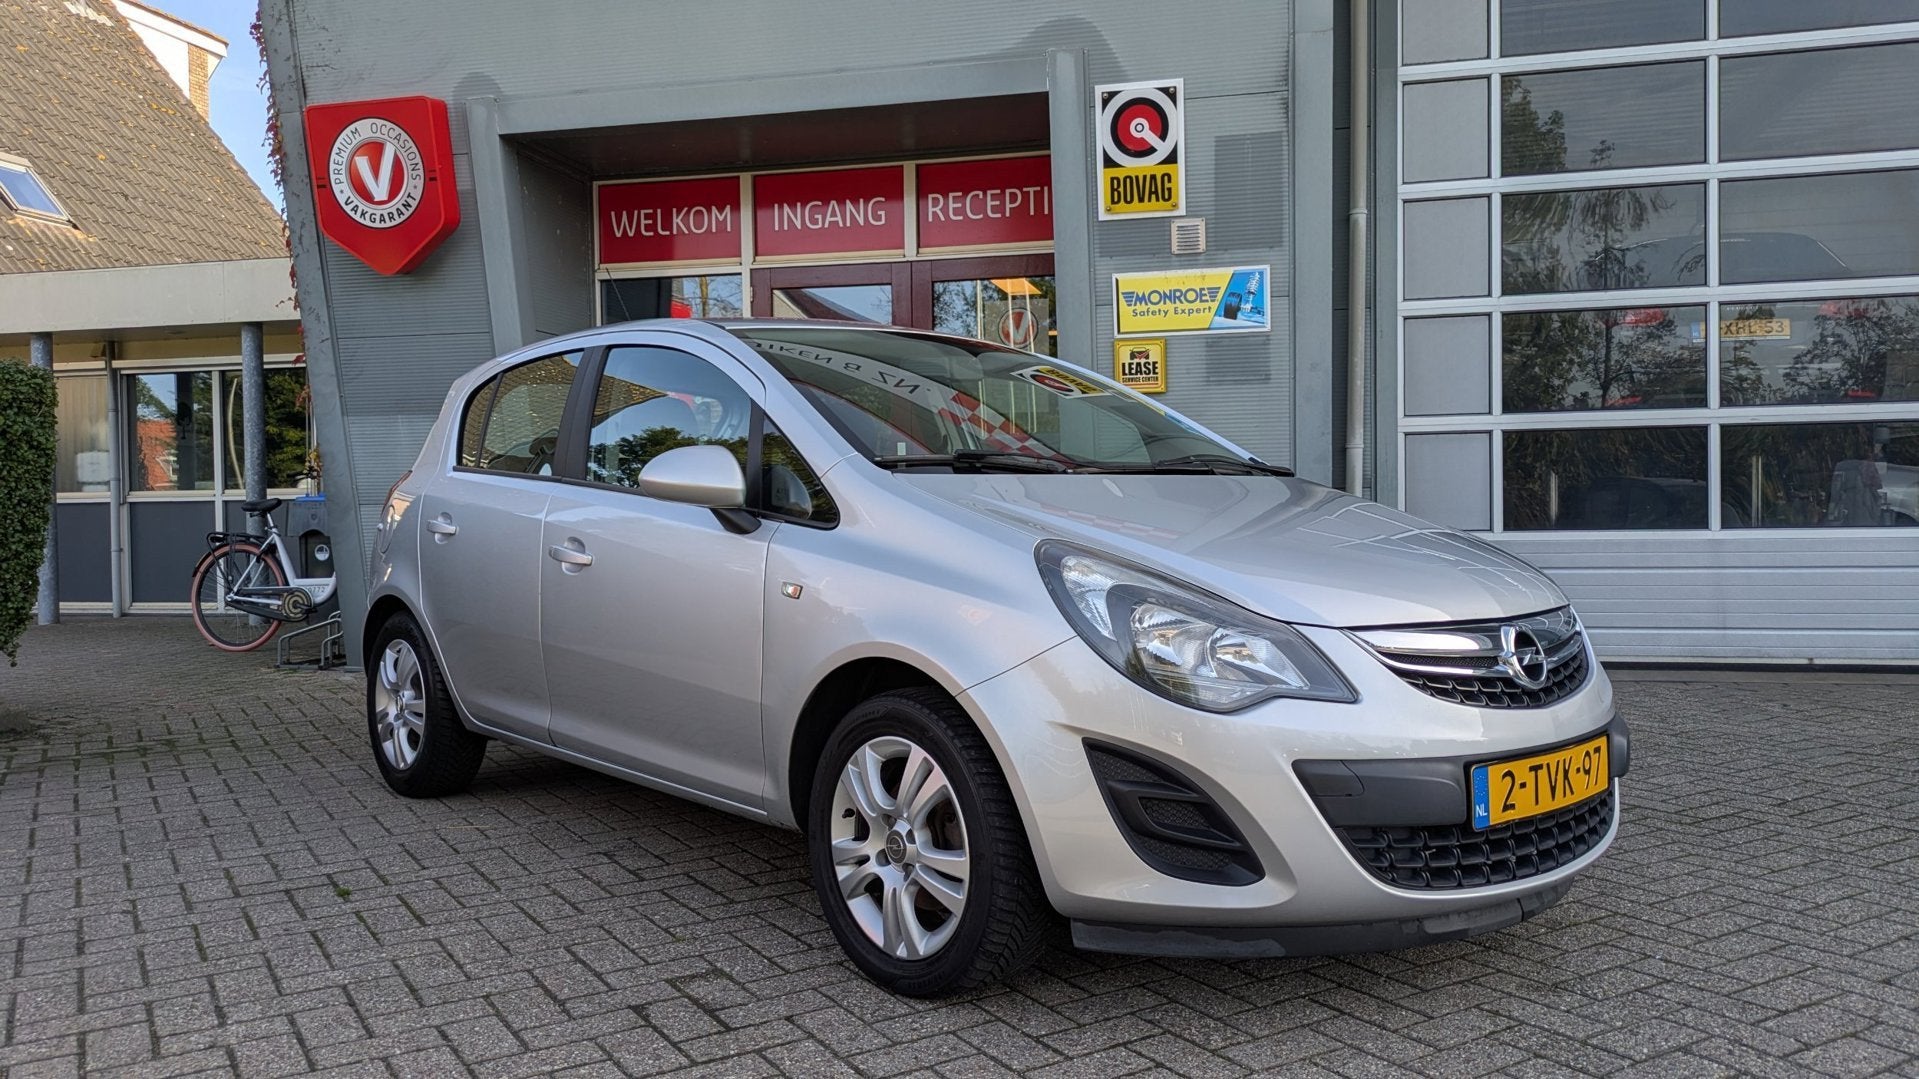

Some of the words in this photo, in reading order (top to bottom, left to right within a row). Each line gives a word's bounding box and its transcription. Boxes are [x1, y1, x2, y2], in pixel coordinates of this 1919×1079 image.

[335, 127, 363, 185] PREMIUM
[370, 122, 421, 181] OCCASIONS
[928, 186, 1049, 222] RECEPTI
[1110, 172, 1172, 205] BOVAG
[344, 191, 417, 224] VAKGARANT
[611, 205, 731, 237] WELKOM
[774, 197, 886, 231] INGANG
[1132, 287, 1209, 307] MONROE
[1132, 306, 1169, 318] Safety
[1174, 306, 1212, 317] Expert
[1121, 361, 1159, 376] LEASE
[1501, 745, 1602, 813] 2-TVK-97
[1475, 804, 1488, 816] NL
